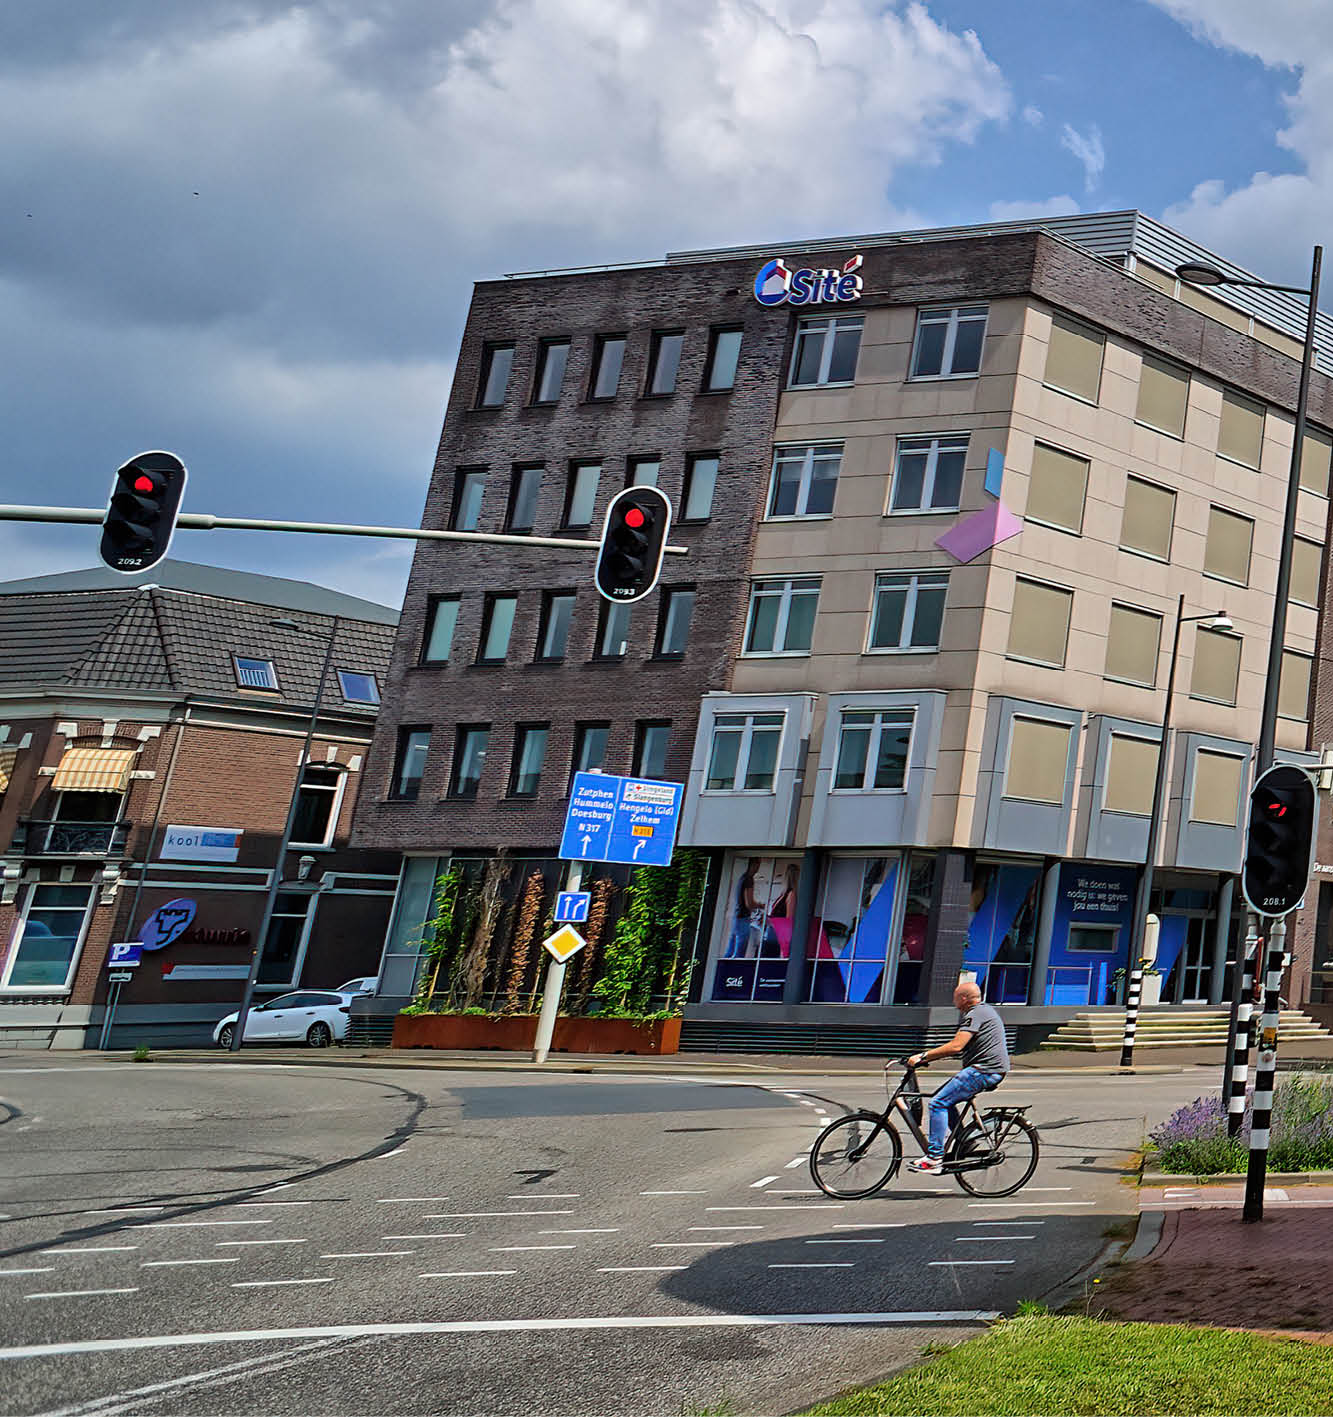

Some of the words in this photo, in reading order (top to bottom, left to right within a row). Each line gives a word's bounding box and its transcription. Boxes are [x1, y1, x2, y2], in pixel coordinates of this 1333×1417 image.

[787, 254, 863, 305] Sité
[578, 787, 614, 799] Zutphen
[573, 798, 614, 810] Hummelo
[619, 802, 653, 814] Hengelo
[571, 808, 612, 822] Doesburg
[630, 814, 661, 824] Zelhem
[168, 834, 199, 847] kool
[1078, 879, 1089, 888] We
[1090, 880, 1107, 890] doen
[1067, 889, 1088, 901] nodig
[1263, 897, 1286, 906] 208.1
[111, 944, 131, 960] P
